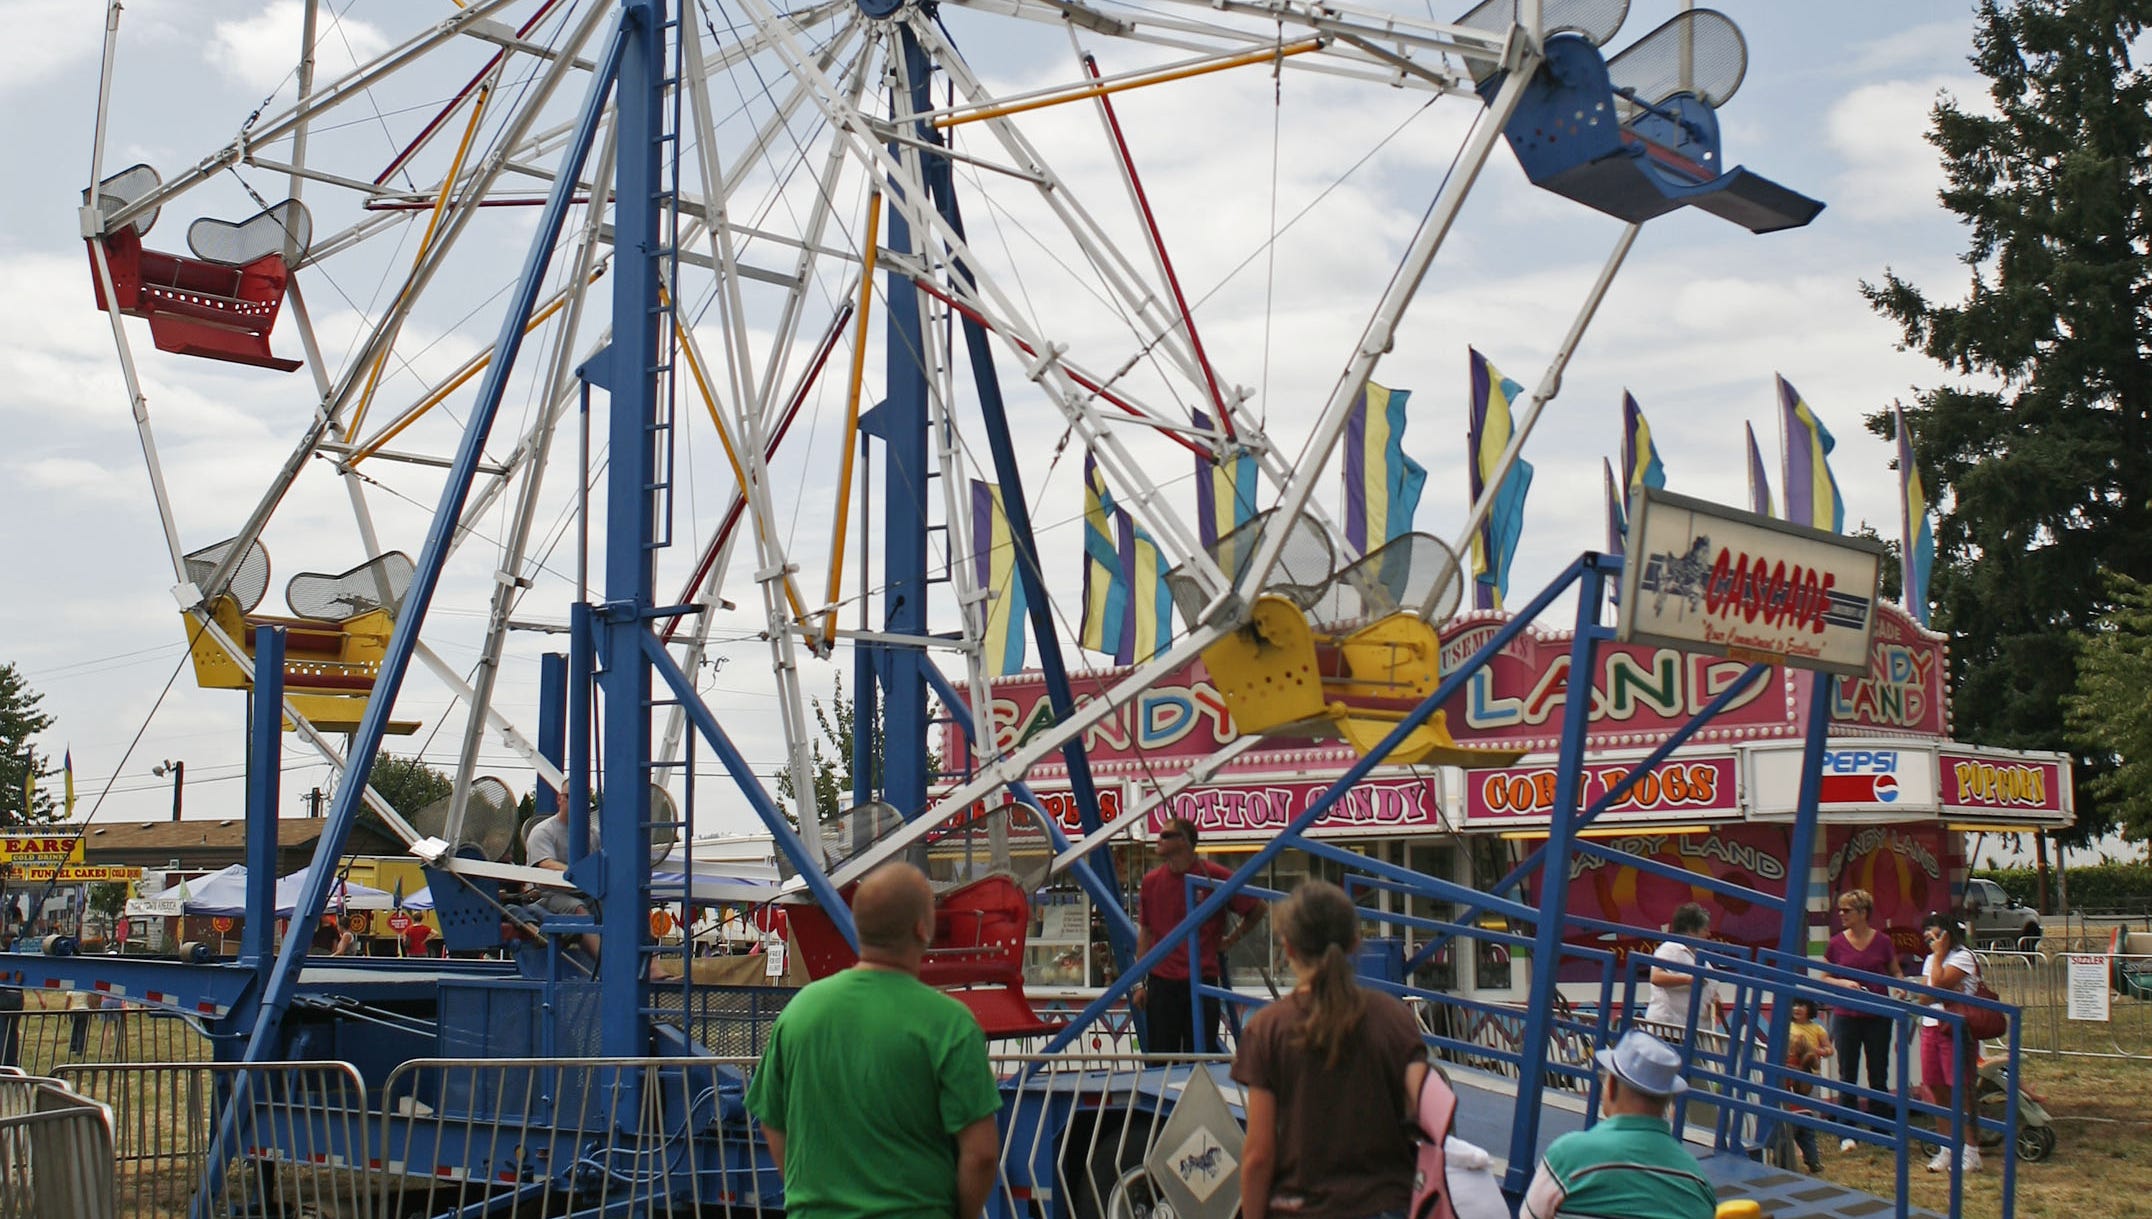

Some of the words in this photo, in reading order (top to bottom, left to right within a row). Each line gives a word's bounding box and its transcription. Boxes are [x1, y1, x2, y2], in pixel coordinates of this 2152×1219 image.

[1705, 546, 1835, 634] CASCADE
[1466, 649, 1772, 729] LAND
[1872, 643, 1933, 689] NDY
[1831, 674, 1926, 726] LAND
[1601, 764, 1718, 811] DOGS
[1955, 760, 2046, 807] POPCORN
[1154, 788, 1292, 829] COTTON
[5, 839, 76, 853] EARS
[1678, 833, 1785, 880] LAND
[1891, 829, 1940, 879] LAND
[31, 869, 71, 878] FUNEL
[74, 868, 107, 878] CAKES
[2071, 956, 2104, 965] SIZZLER
